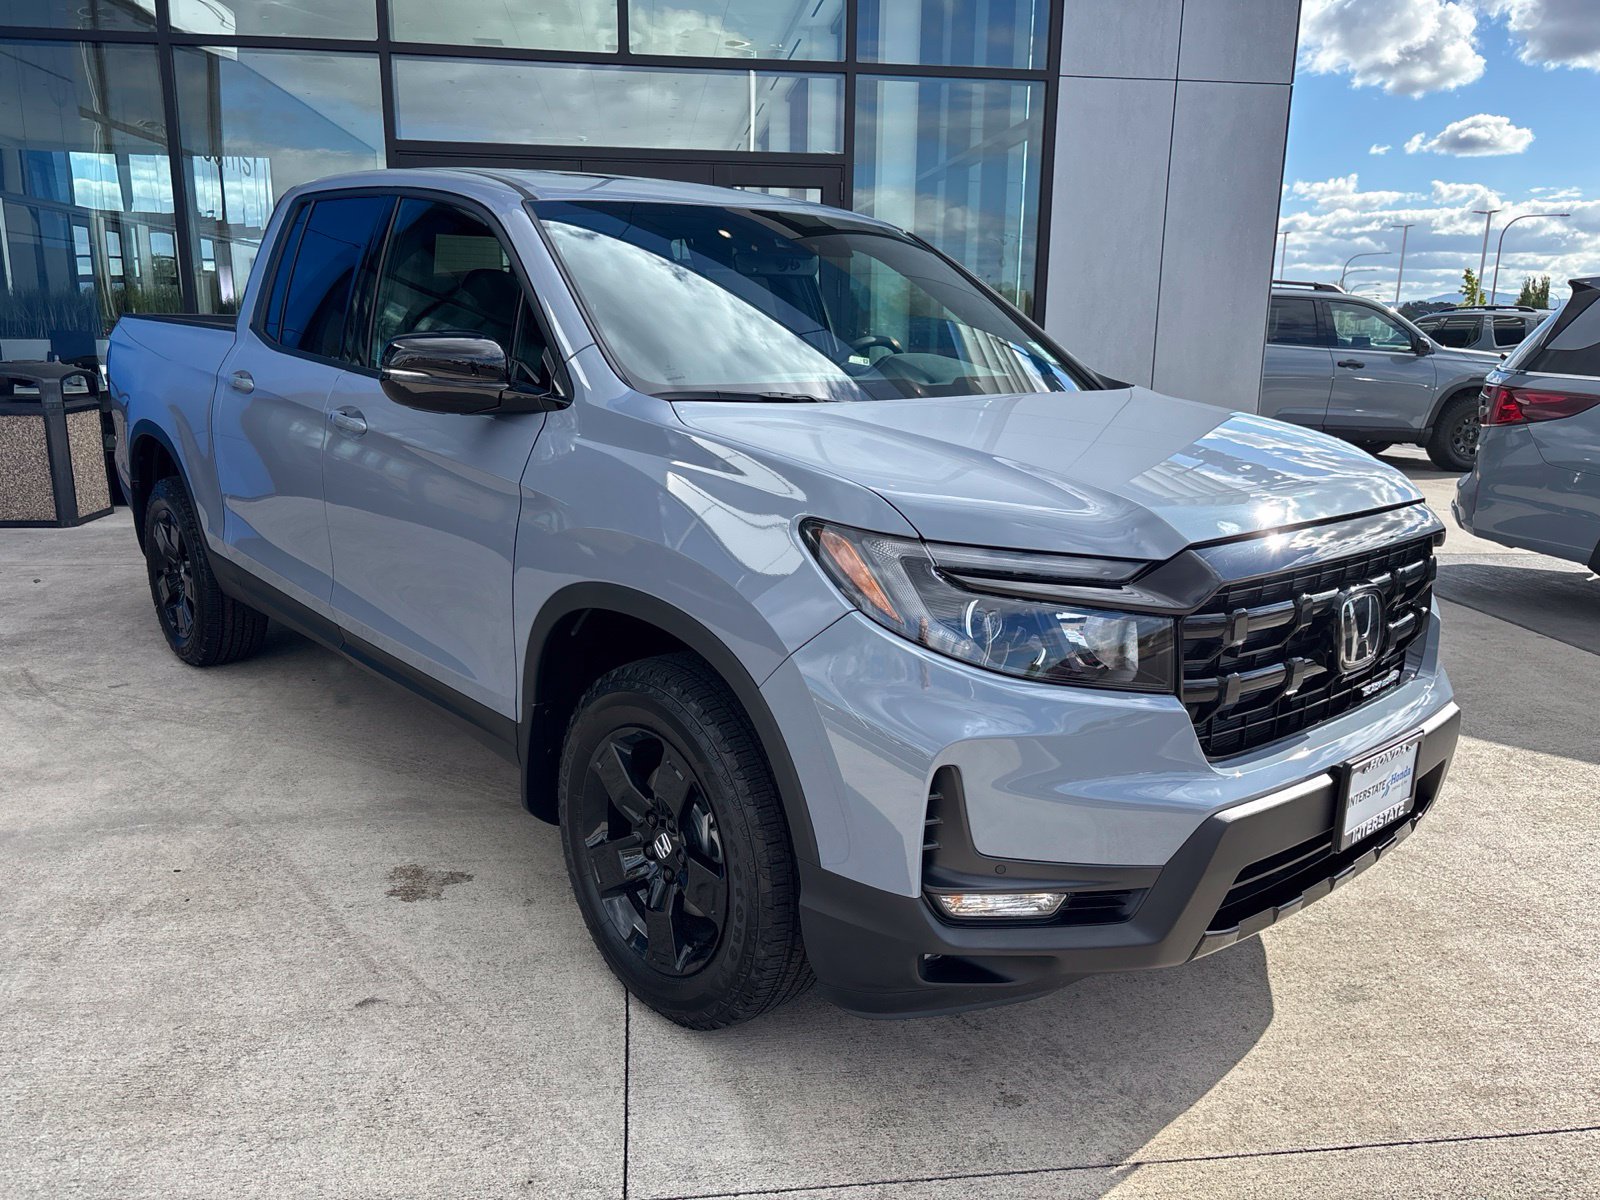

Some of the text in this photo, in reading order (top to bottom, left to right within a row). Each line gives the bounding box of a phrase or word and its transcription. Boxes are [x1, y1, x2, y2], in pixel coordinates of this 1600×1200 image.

[1368, 745, 1408, 770] HONDA
[1348, 779, 1386, 808] NTERSTATE
[1391, 766, 1411, 784] Honda
[1352, 802, 1404, 843] INTERSTATE
